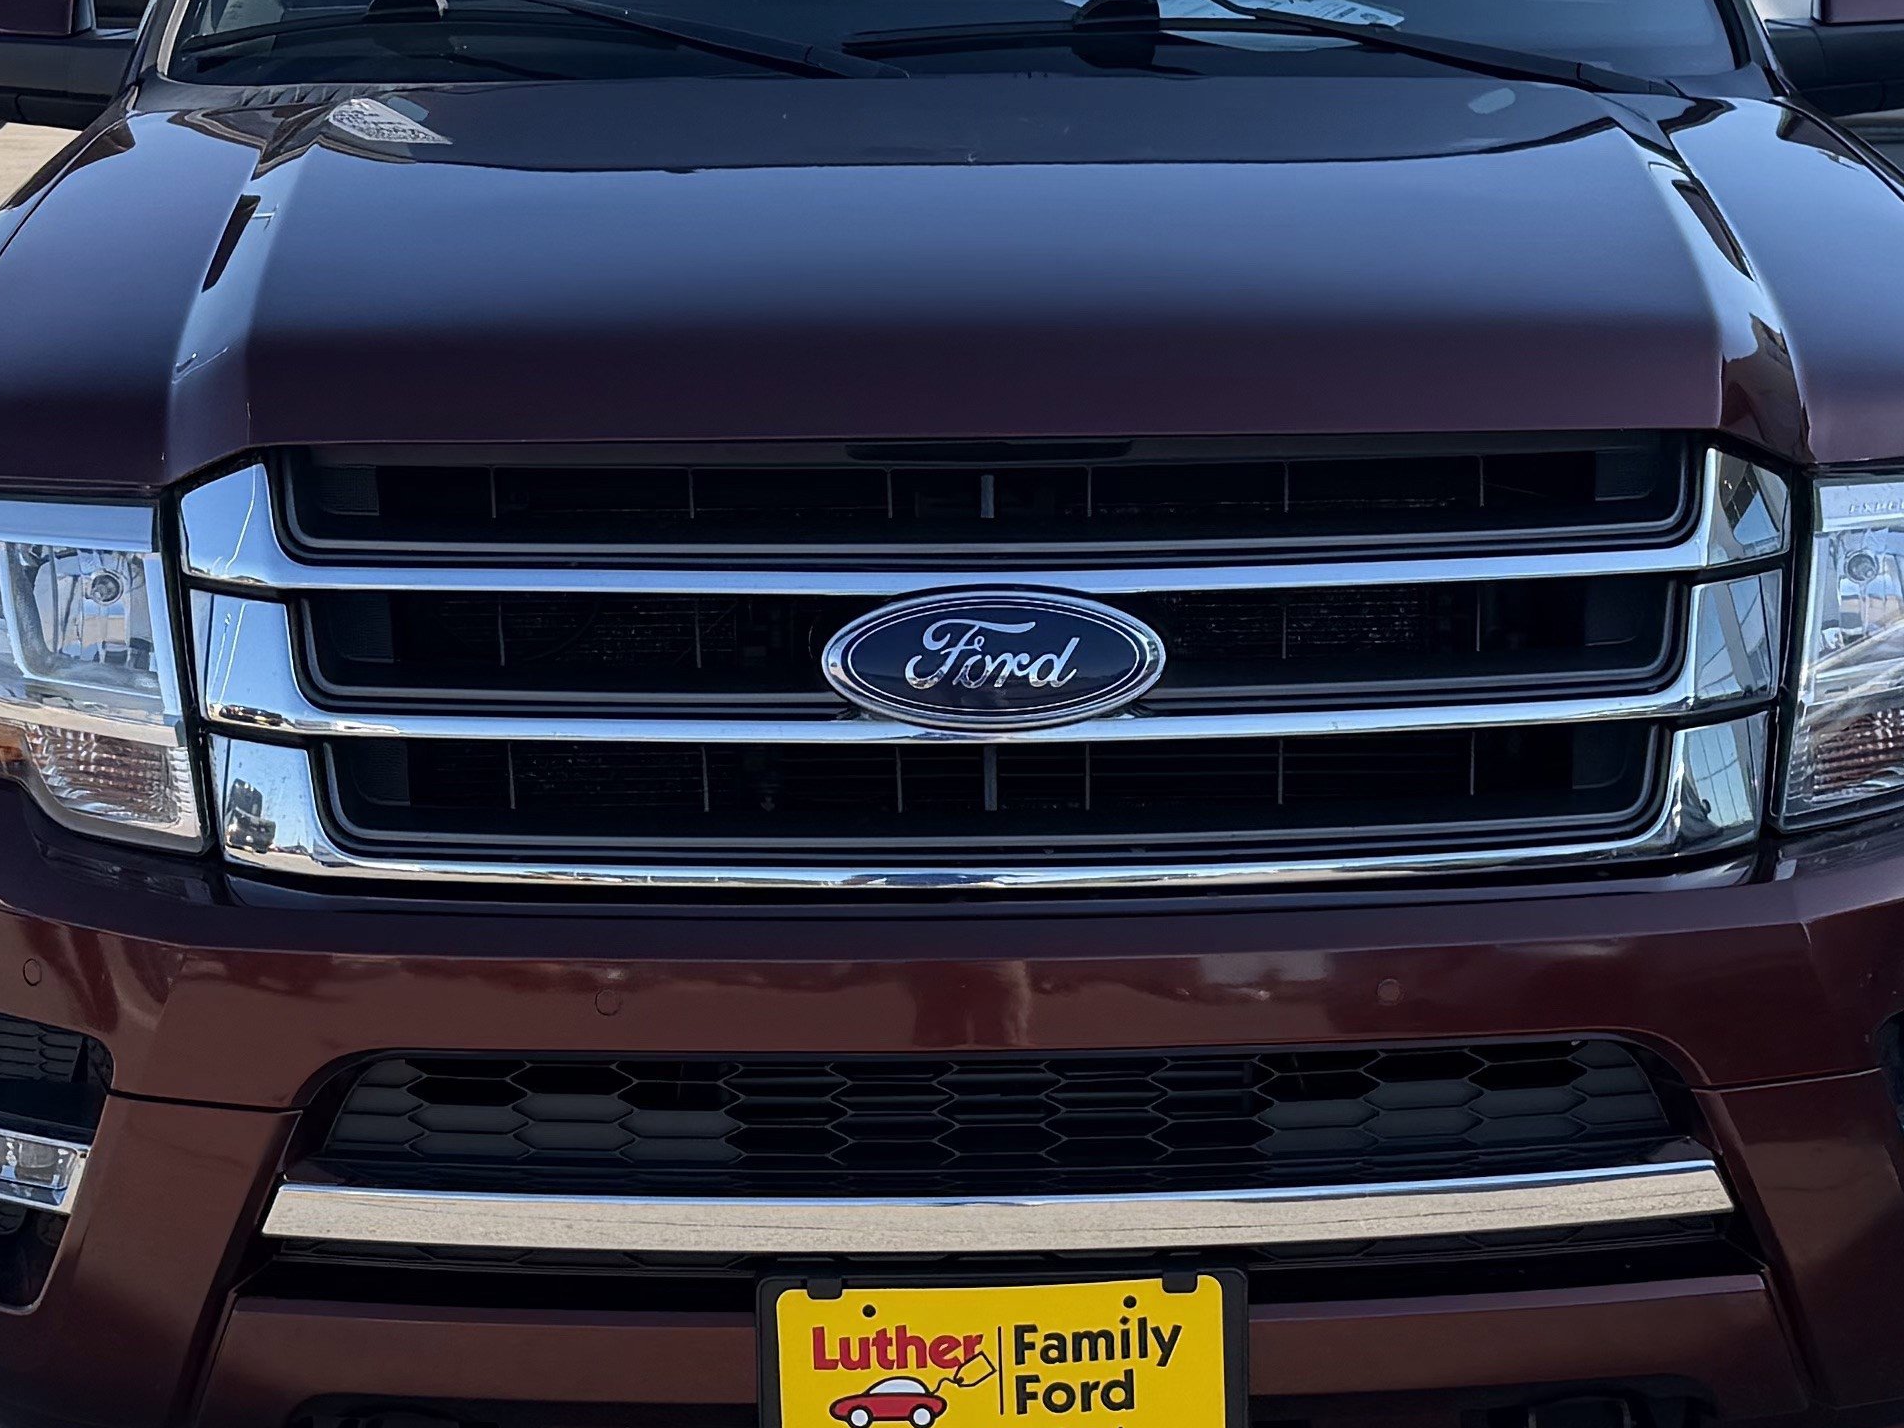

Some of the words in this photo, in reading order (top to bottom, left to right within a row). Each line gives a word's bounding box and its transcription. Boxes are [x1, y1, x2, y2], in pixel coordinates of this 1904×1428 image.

[904, 618, 1080, 690] Ford
[811, 1324, 984, 1372] Luther
[1013, 1315, 1183, 1368] Family
[1014, 1368, 1136, 1416] Ford
